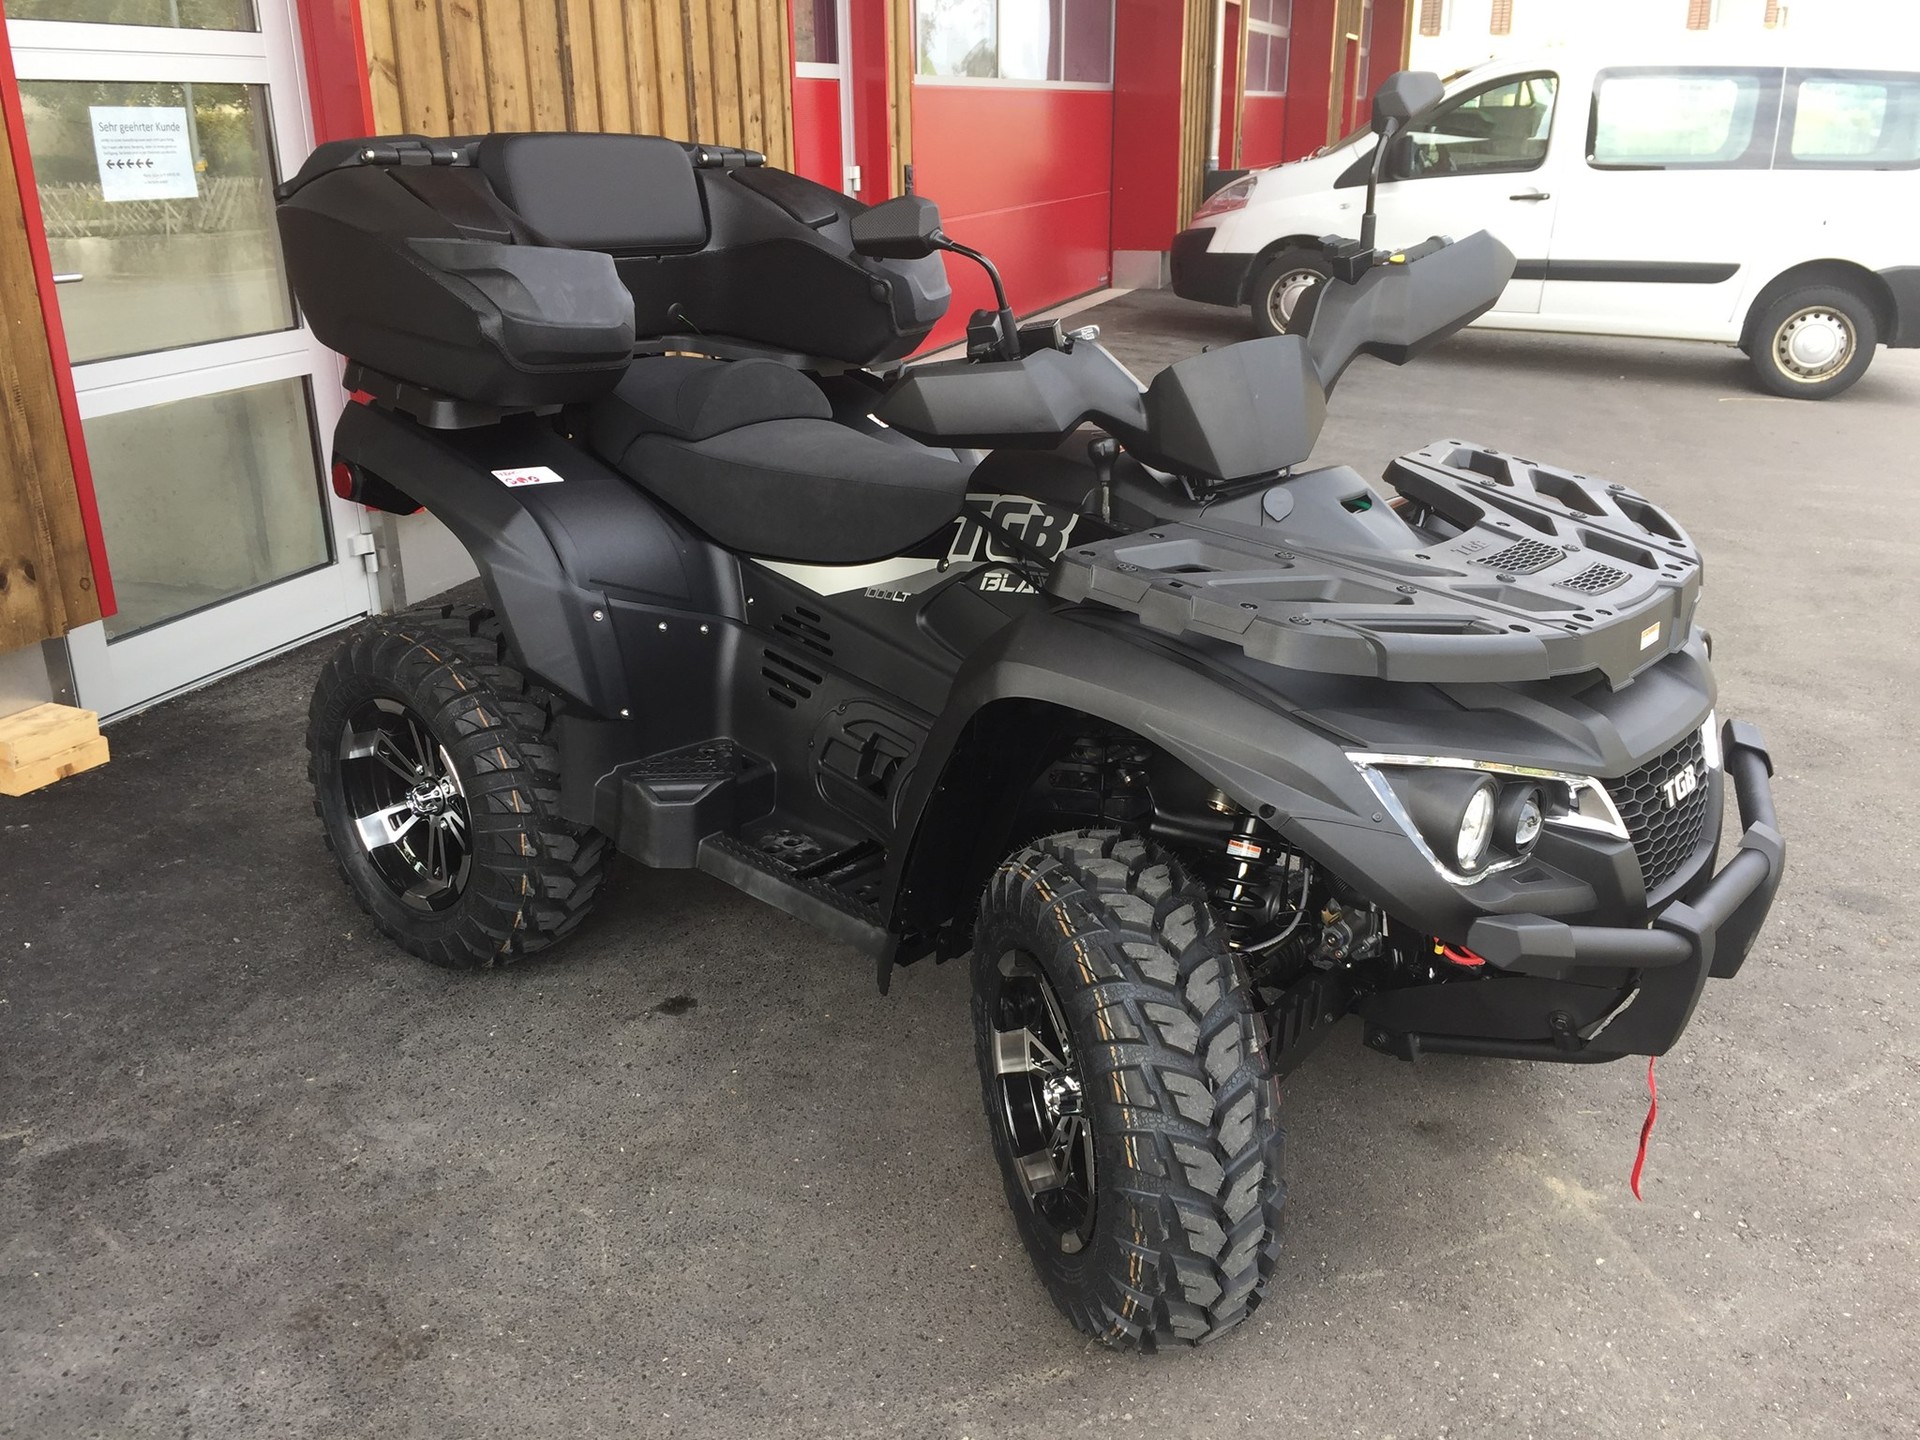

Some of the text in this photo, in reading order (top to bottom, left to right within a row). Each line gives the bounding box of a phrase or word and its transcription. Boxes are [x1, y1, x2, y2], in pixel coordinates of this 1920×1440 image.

[98, 121, 181, 135] Sehr geehrter Kunde
[947, 493, 1080, 563] TGB
[864, 587, 912, 603] 1000LT
[1662, 763, 1697, 809] TGB
